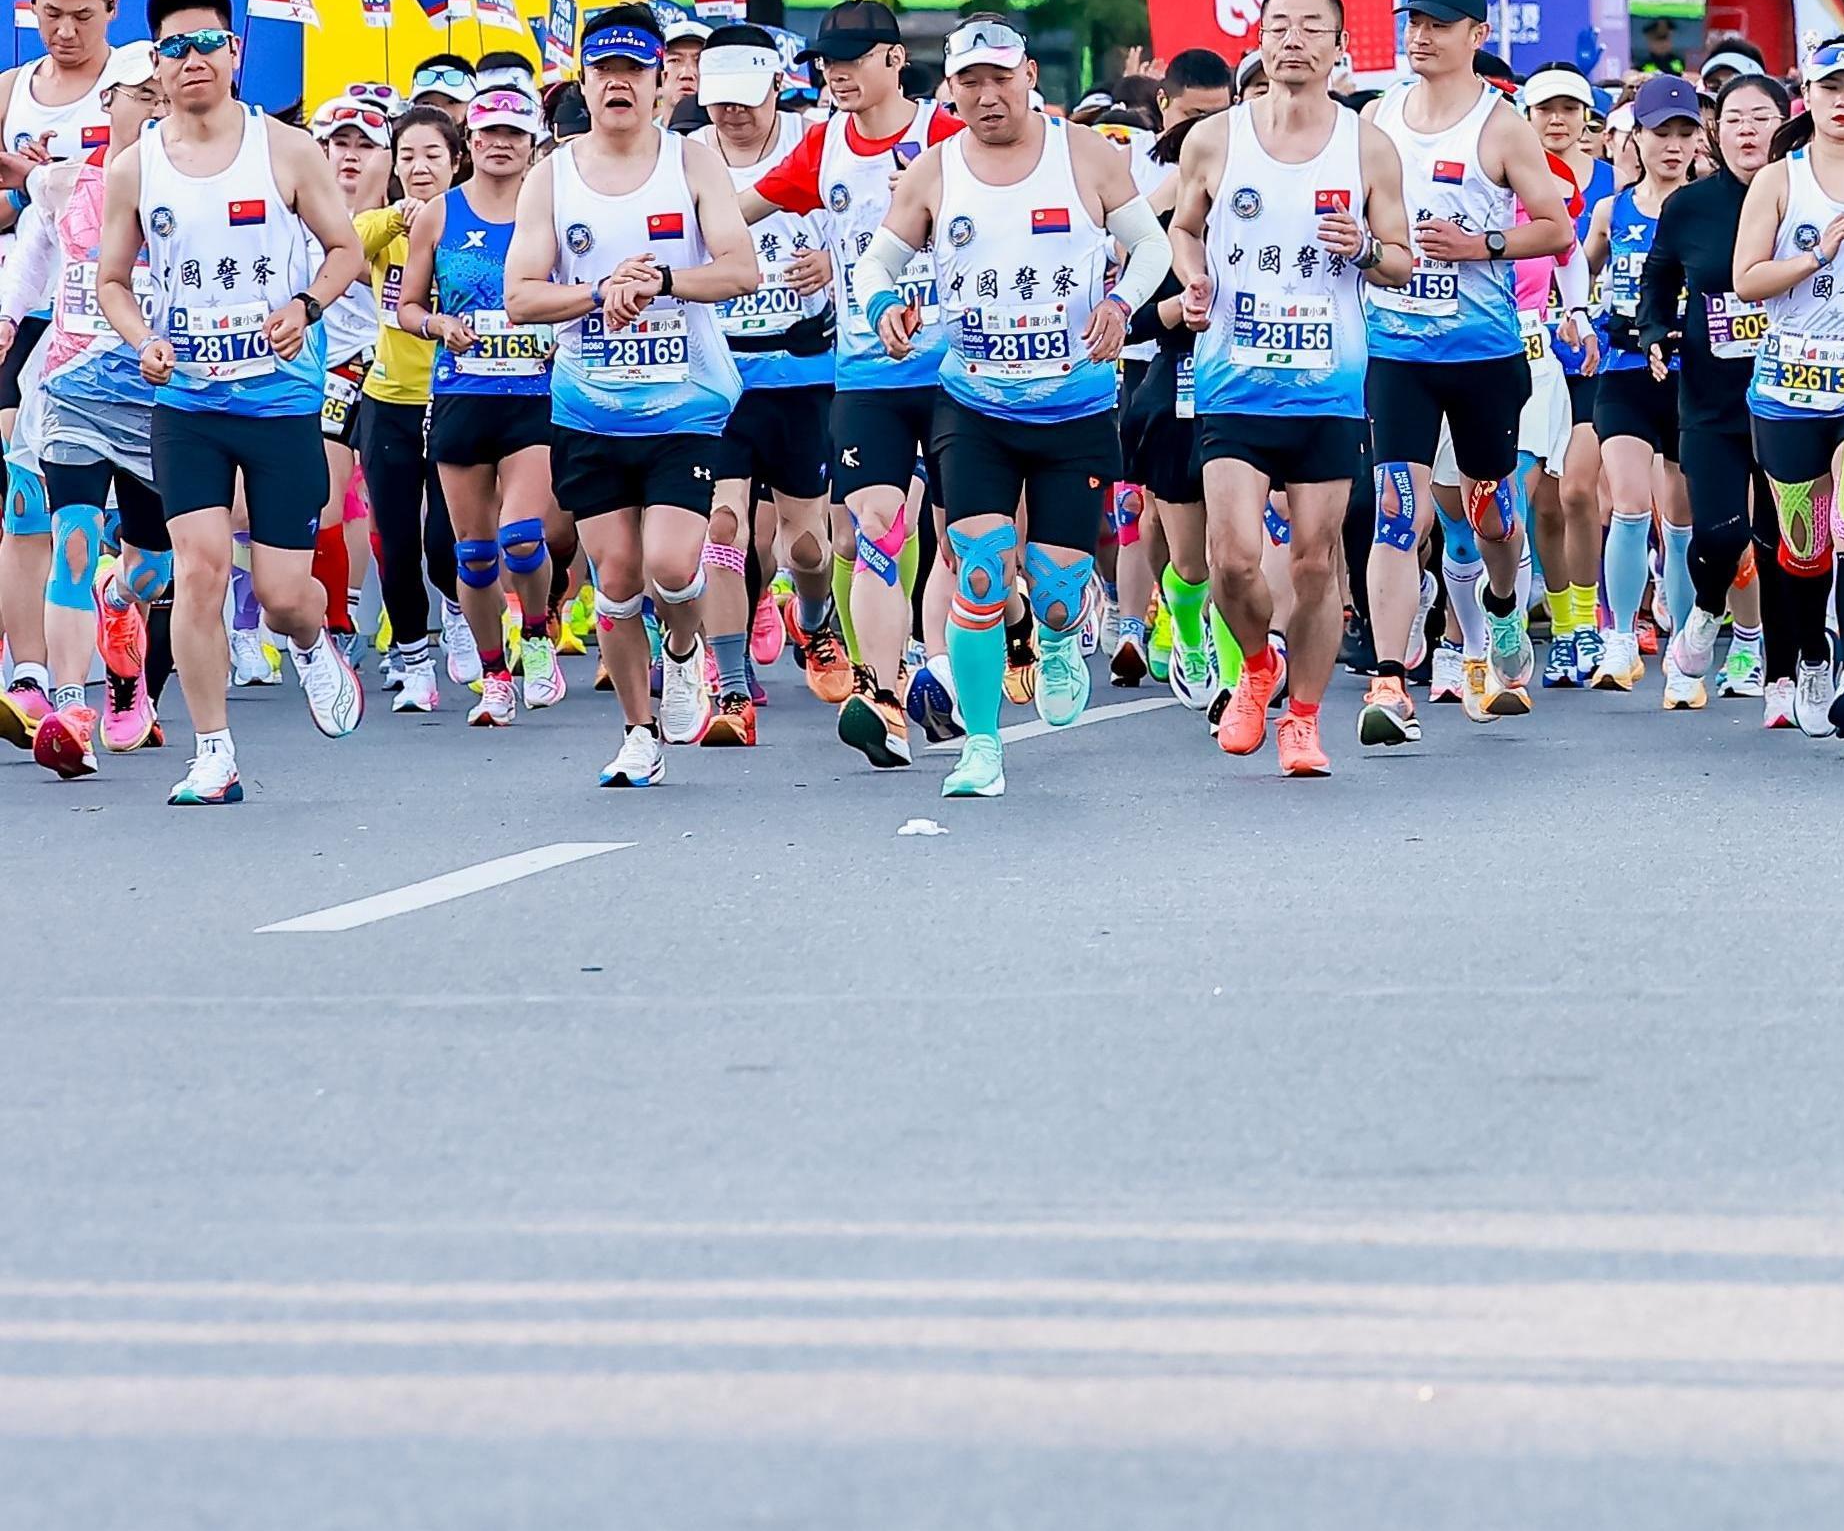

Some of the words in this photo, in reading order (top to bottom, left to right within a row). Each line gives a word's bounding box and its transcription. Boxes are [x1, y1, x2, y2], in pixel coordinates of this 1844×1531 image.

[1616, 256, 1628, 271] D
[390, 270, 400, 284] D
[950, 265, 1080, 301] 中國警察
[729, 288, 799, 316] 28200
[1240, 297, 1253, 312] D
[1712, 299, 1722, 313] D
[174, 311, 187, 329] D
[589, 318, 601, 333] D
[967, 312, 980, 326] D
[1256, 325, 1329, 349] 28156
[1767, 336, 1780, 353] D
[194, 332, 269, 362] 28170
[609, 337, 685, 366] 28169
[989, 333, 1066, 360] 28193
